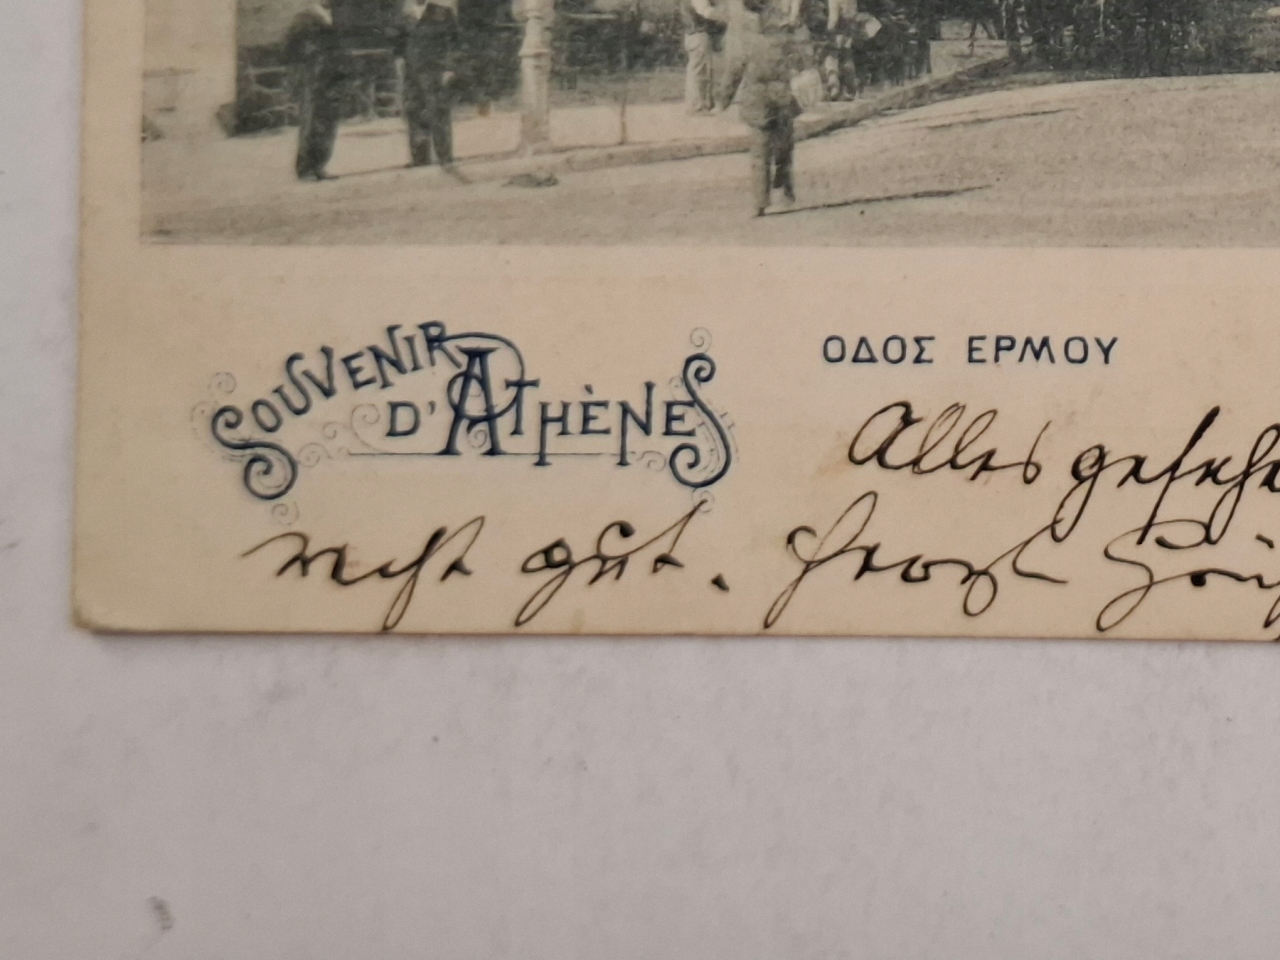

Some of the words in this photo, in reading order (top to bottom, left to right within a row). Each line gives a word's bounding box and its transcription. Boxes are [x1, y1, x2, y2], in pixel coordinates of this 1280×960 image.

[822, 335, 936, 364] ΟΔΟΣ
[967, 335, 1119, 365] ΕΡΜΟΥ
[210, 321, 464, 499] SOUVENIR
[848, 401, 1050, 486] Alles
